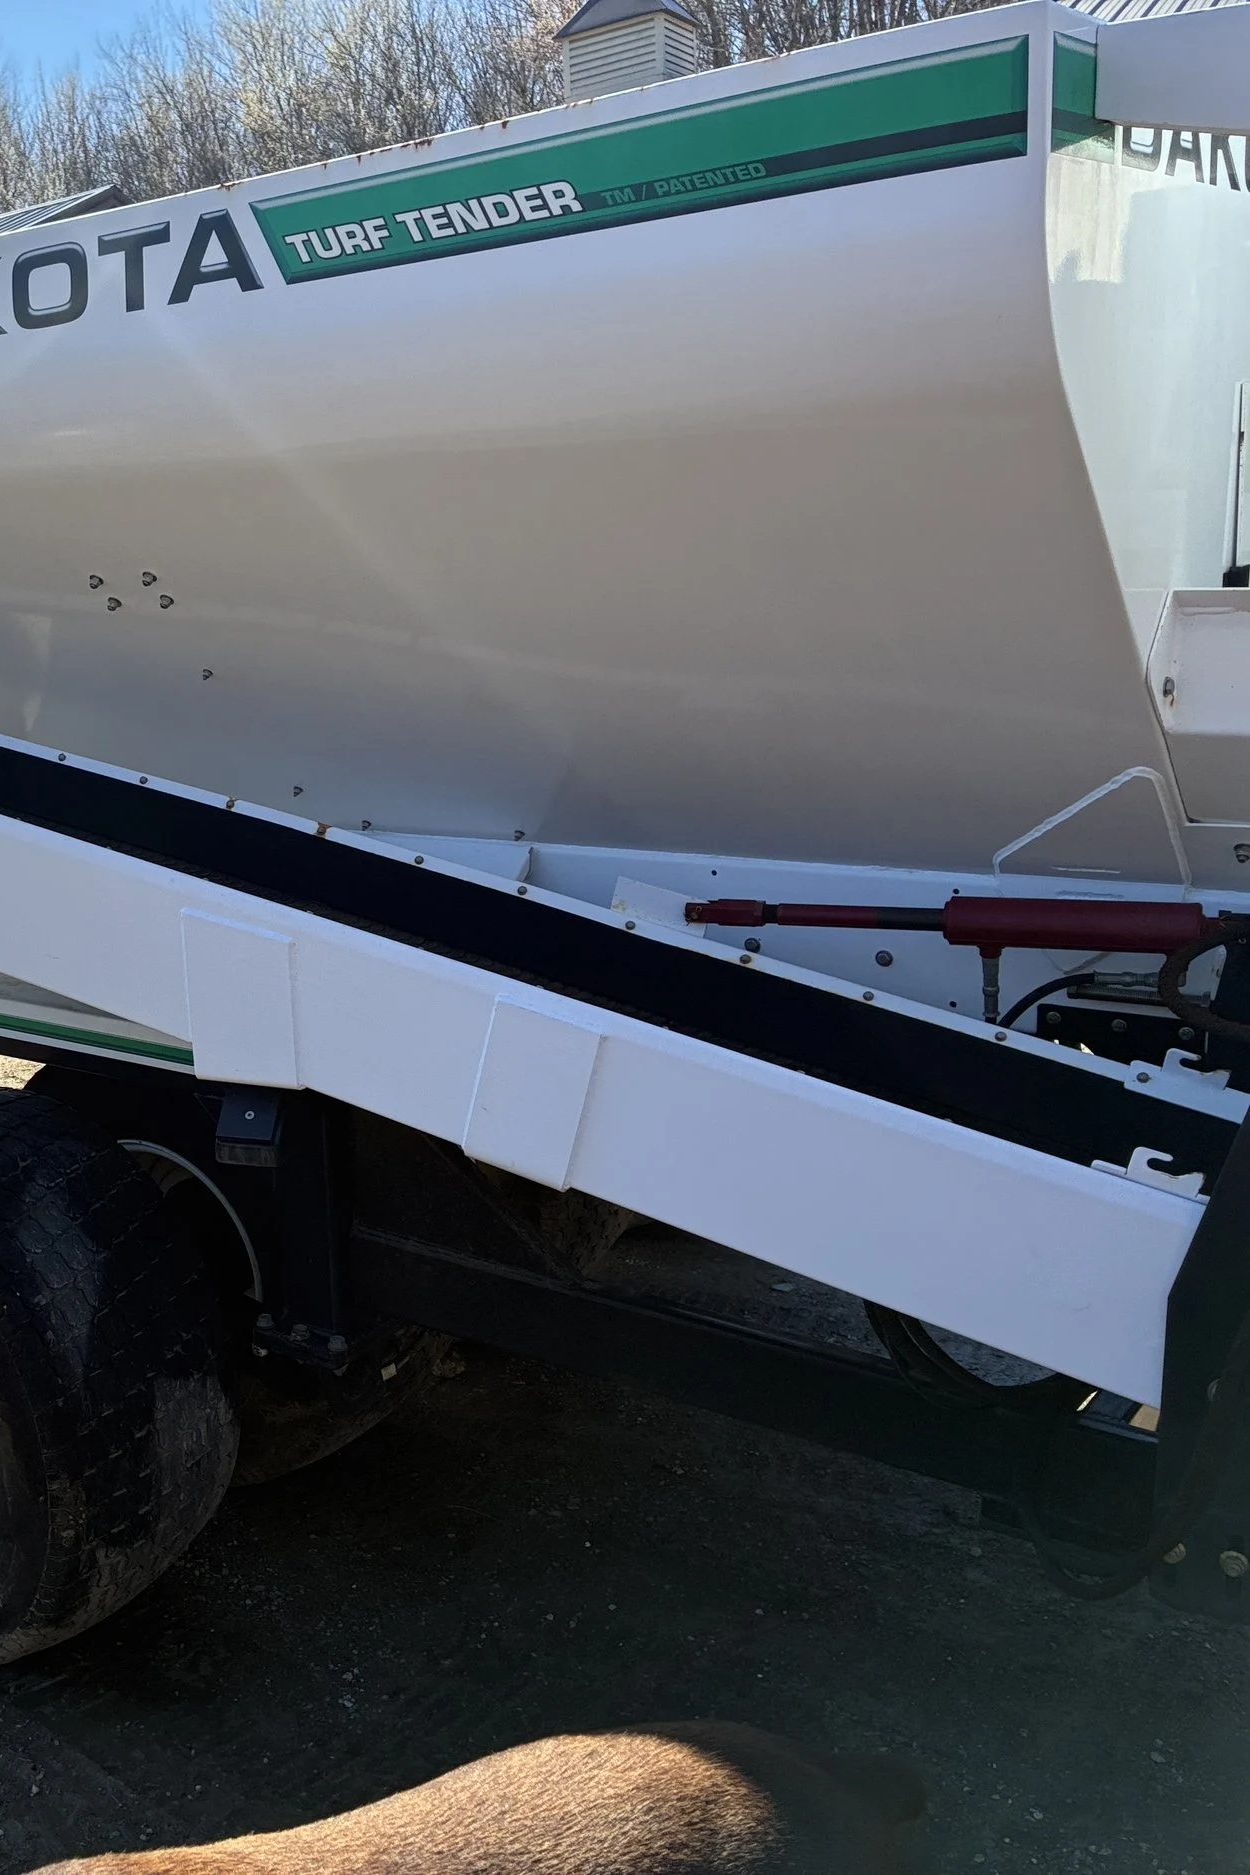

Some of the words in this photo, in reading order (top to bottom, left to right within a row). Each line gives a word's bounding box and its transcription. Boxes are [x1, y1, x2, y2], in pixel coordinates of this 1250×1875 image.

[1121, 124, 1250, 193] DAK
[284, 216, 391, 264] TURF
[394, 179, 584, 243] TENDER
[601, 189, 636, 206] TM
[654, 162, 766, 196] PATENTED
